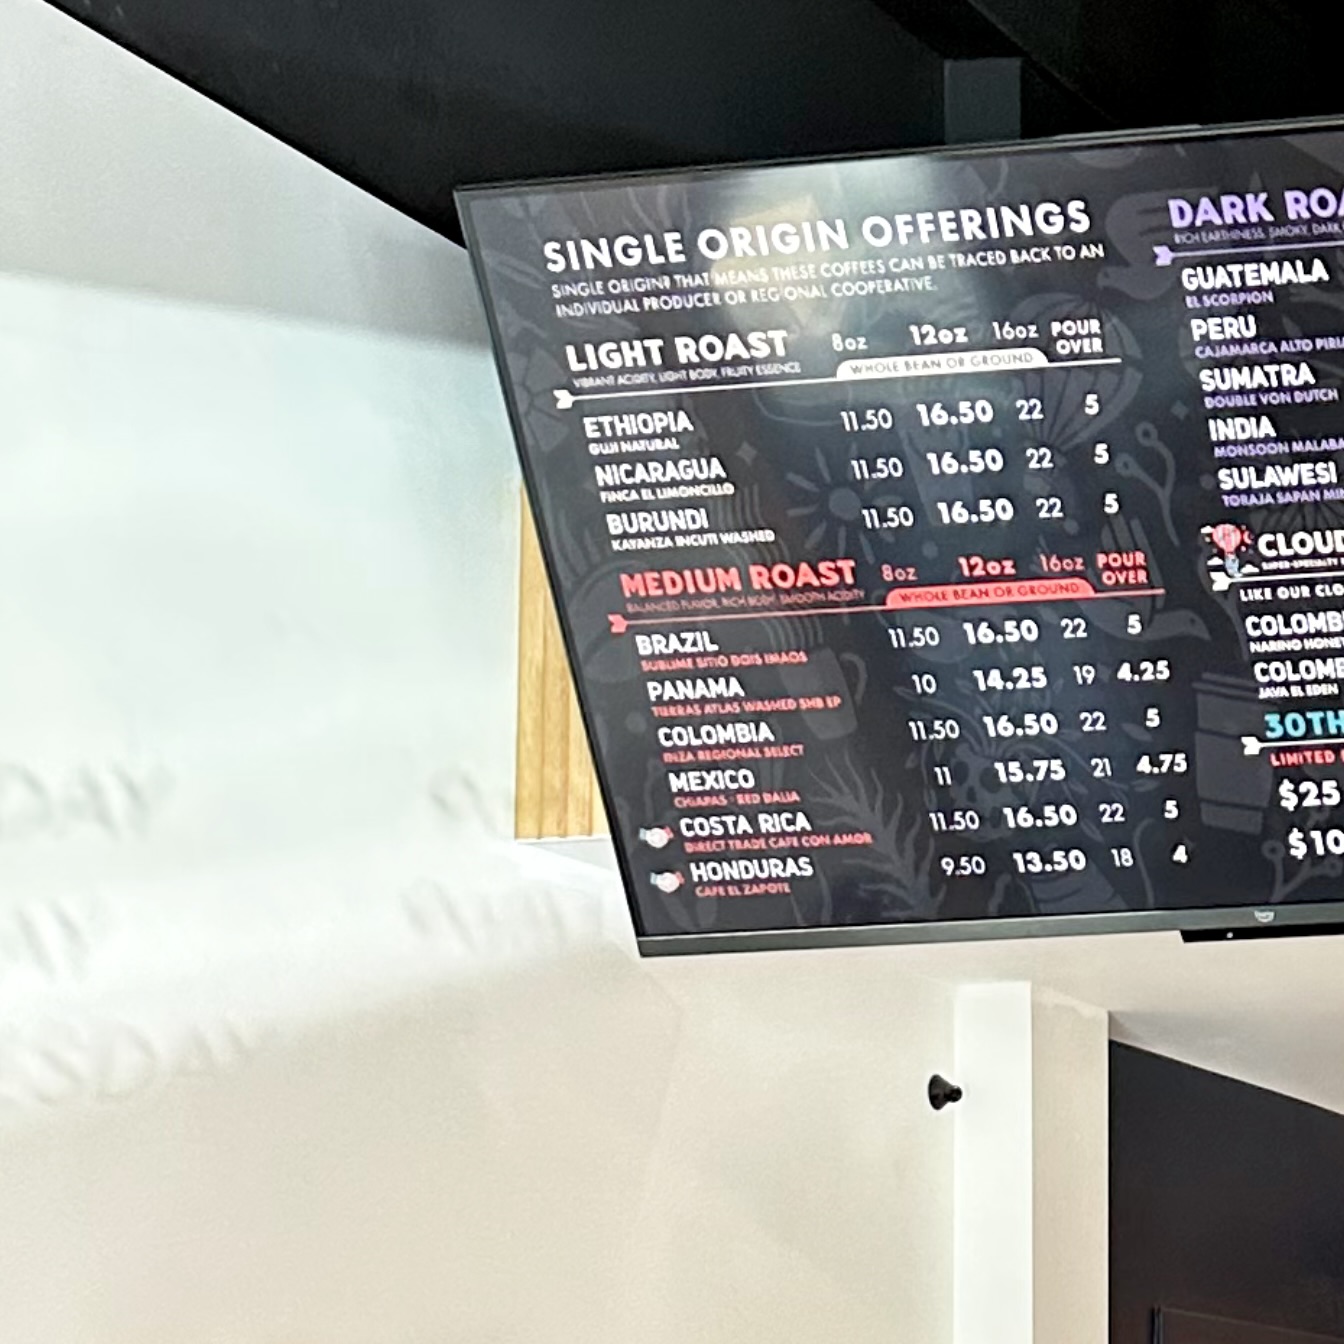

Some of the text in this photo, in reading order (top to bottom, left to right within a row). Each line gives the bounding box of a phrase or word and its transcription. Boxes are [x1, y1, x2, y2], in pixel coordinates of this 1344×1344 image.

[1168, 193, 1273, 228] DARK
[544, 199, 1092, 273] SINGLE ORIGIN OFFERINGS
[1181, 258, 1329, 291] GUATEMALA
[1190, 315, 1256, 341] PERU
[565, 330, 790, 371] LIGHT ROAST
[1199, 362, 1316, 392] SUMATRA
[583, 411, 694, 438] ETHIOPIA
[1208, 416, 1276, 441] INDIA
[595, 458, 726, 487] NICARAGUA
[1218, 461, 1337, 490] SULAWESI
[606, 508, 709, 535] BURUNDI
[620, 560, 855, 598] MEDIUM ROAST
[635, 631, 719, 655] BRAZIL
[647, 677, 745, 701] PANAMA
[658, 722, 775, 747] COLOMBIA
[1270, 750, 1335, 766] LIMITED
[669, 769, 755, 792] MEXICO
[1279, 779, 1340, 811] $25
[680, 812, 812, 837] COSTA RICA
[690, 857, 813, 882] HONDURAS
